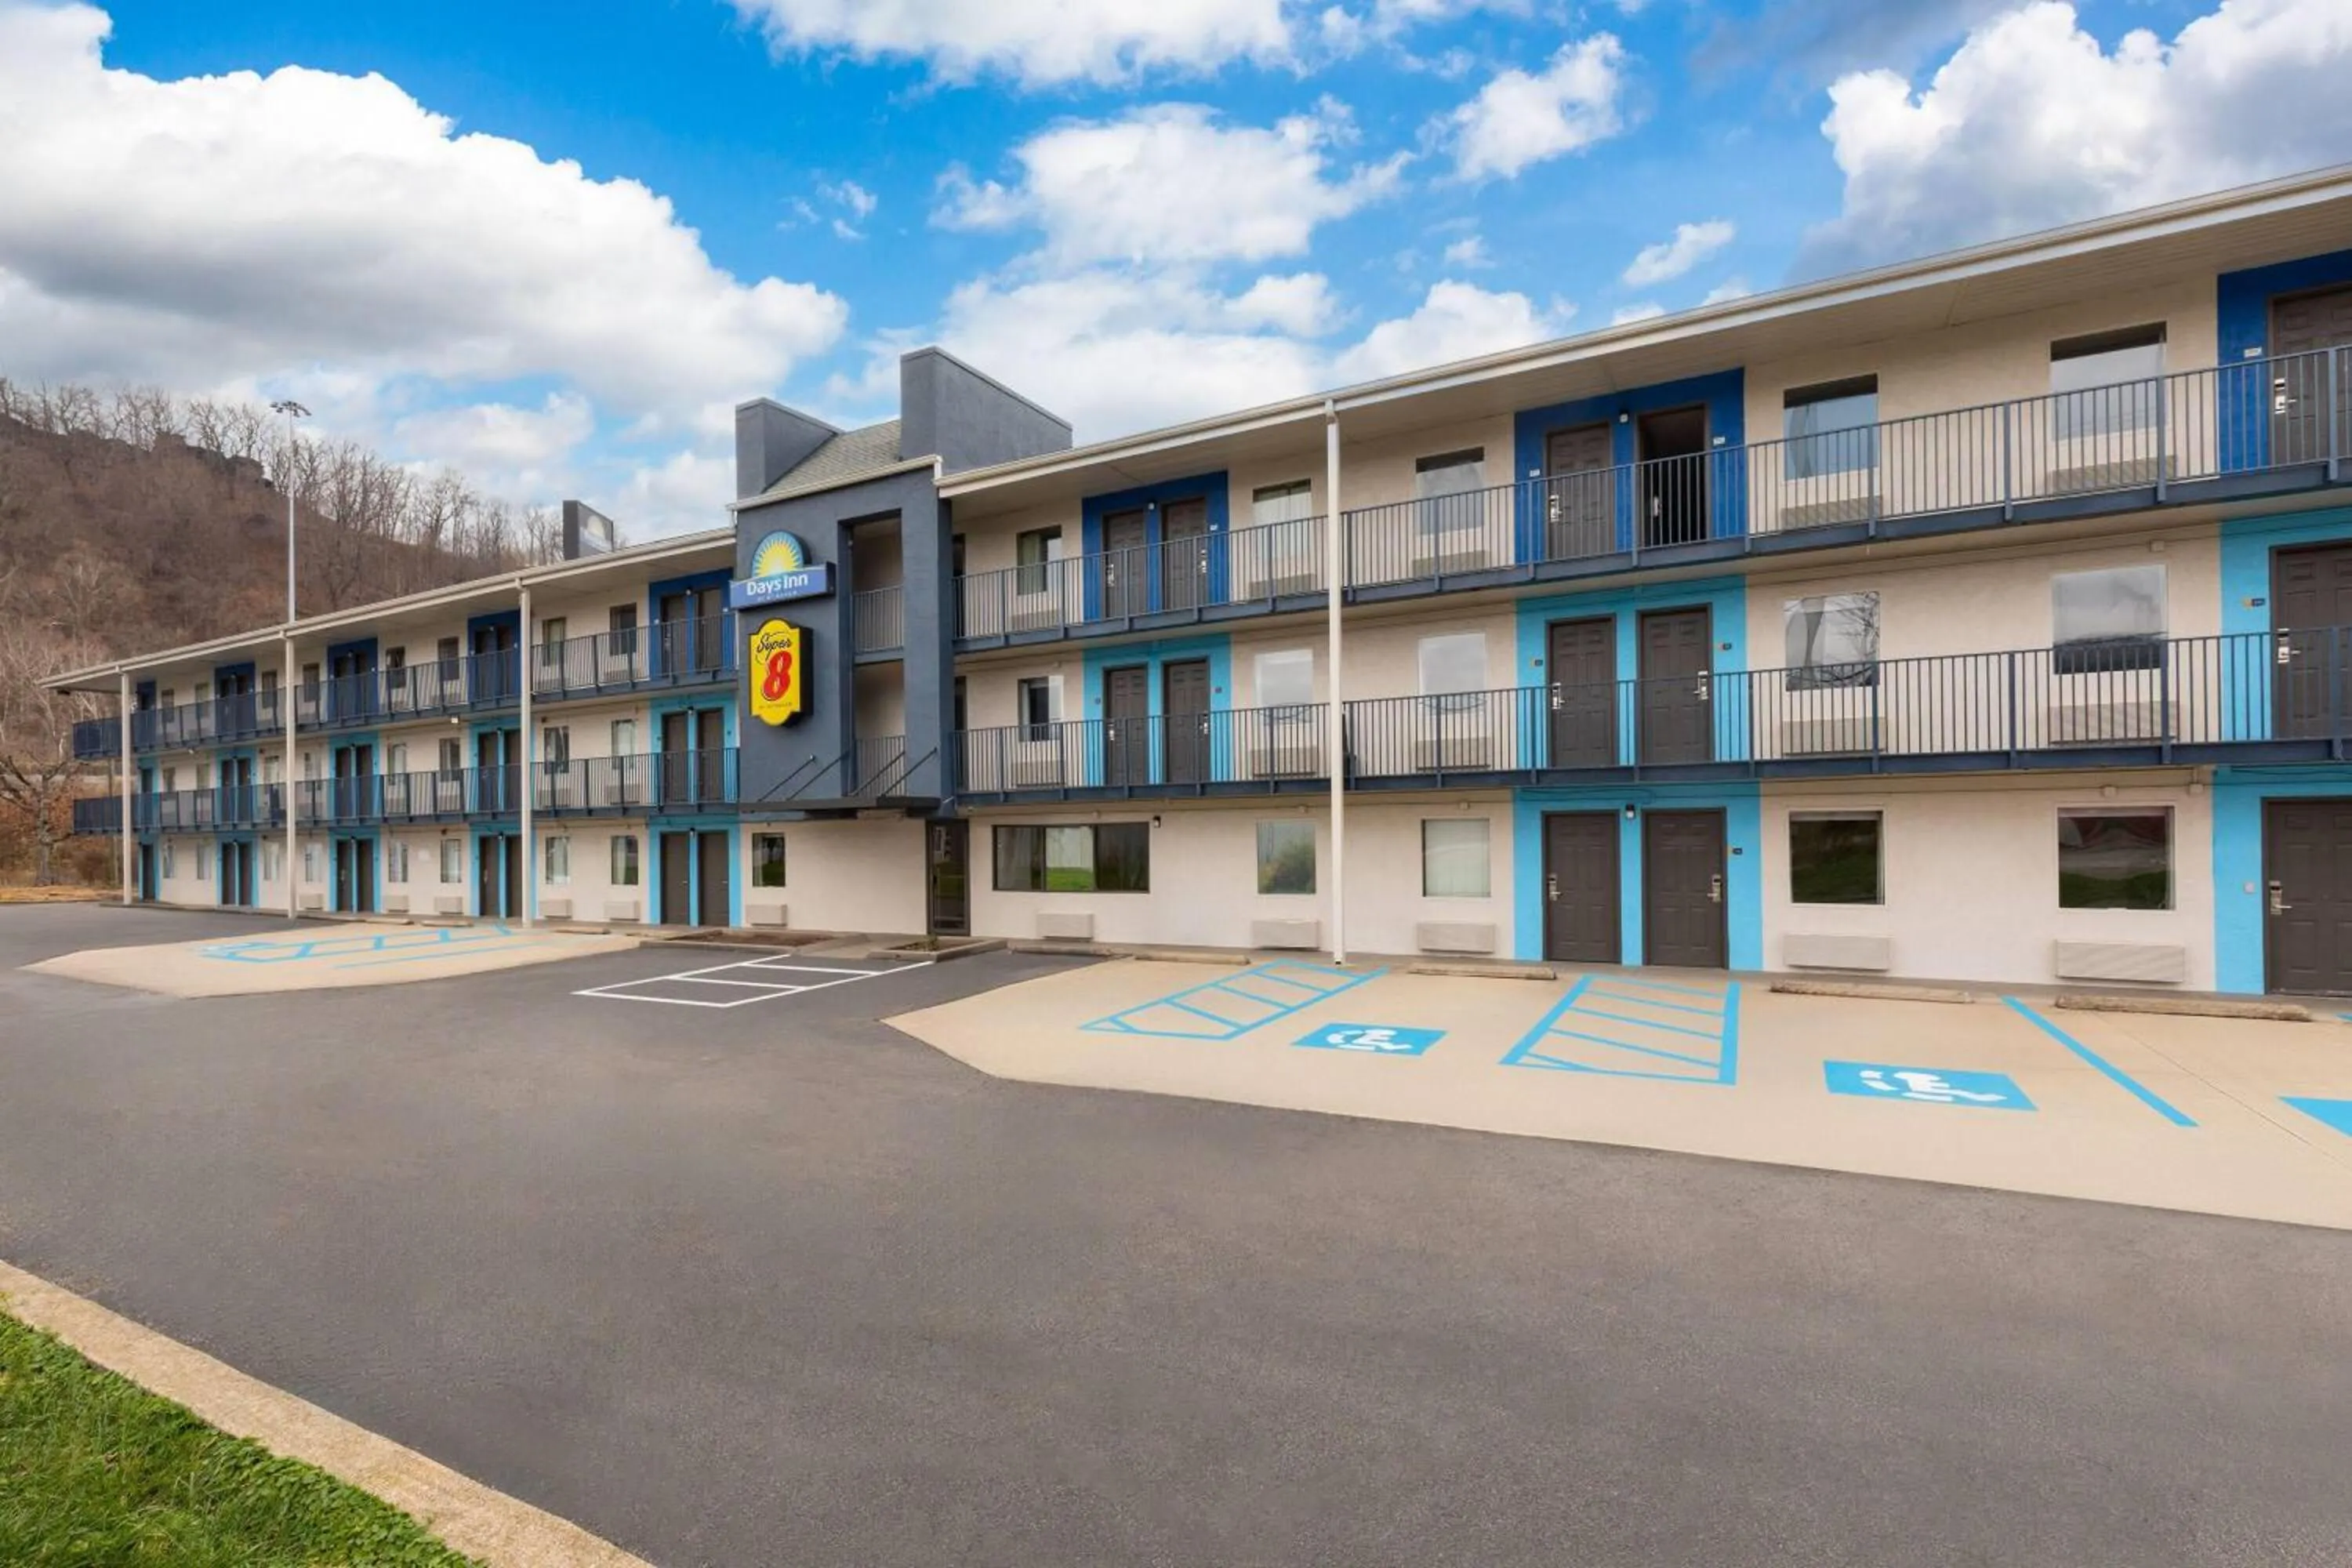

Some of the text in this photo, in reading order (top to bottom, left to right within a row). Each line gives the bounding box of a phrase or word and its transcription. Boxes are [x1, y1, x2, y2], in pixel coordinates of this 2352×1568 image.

[746, 573, 808, 596] Days Inn
[757, 633, 792, 661] Super
[761, 651, 793, 701] 8
